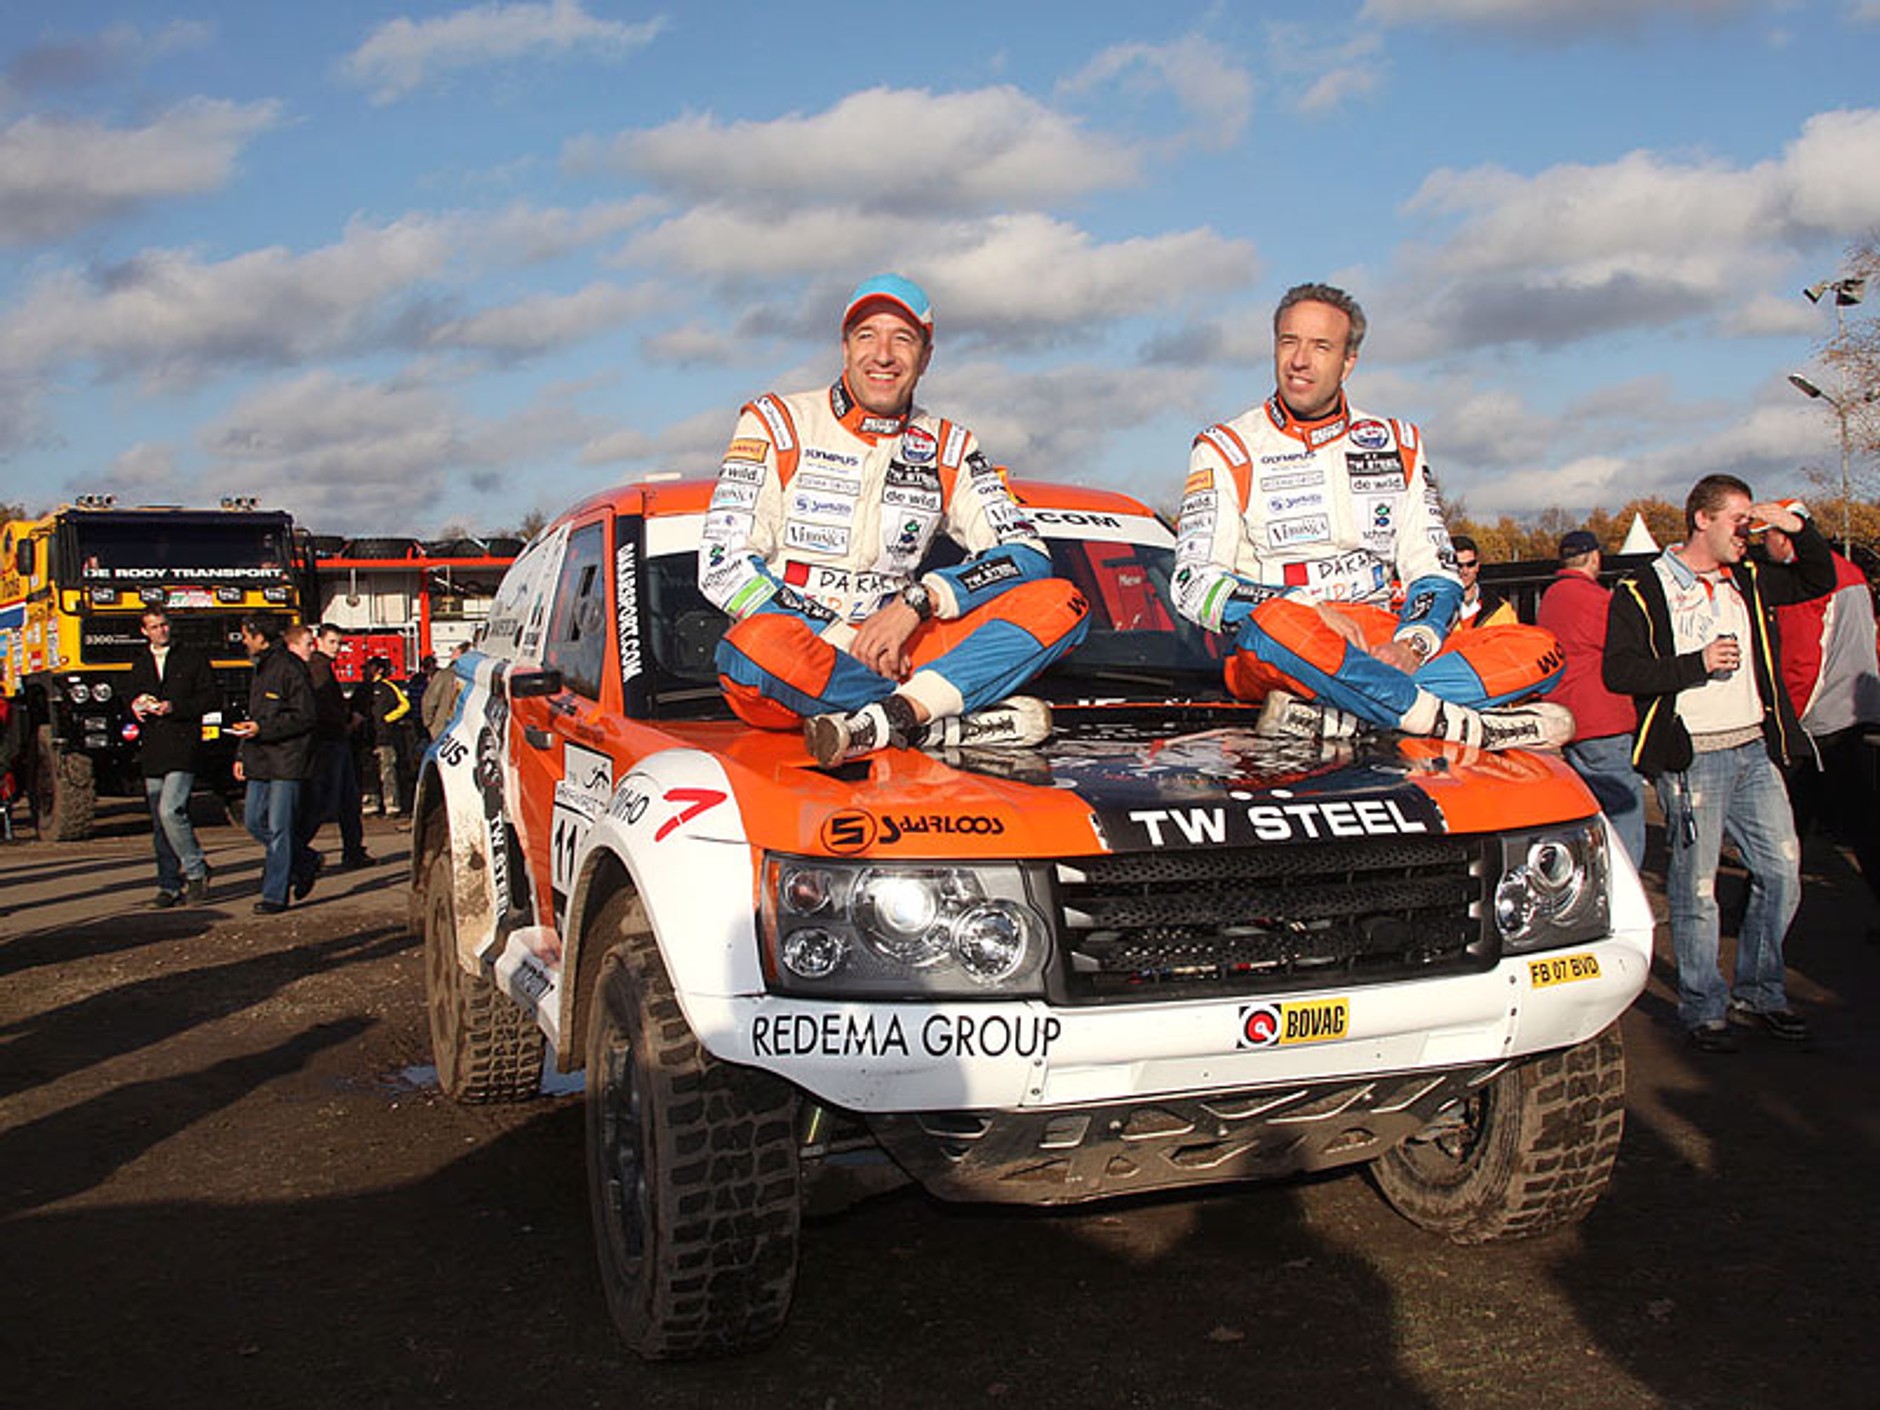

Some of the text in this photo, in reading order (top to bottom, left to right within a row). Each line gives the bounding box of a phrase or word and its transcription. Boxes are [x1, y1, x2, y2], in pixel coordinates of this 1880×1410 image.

[886, 489, 905, 501] de
[171, 568, 283, 578] TRANSPORT
[1130, 800, 1428, 847] TW STEEL
[1531, 961, 1550, 984] FB
[1553, 960, 1567, 980] 07
[752, 1014, 1062, 1057] REDEMA GROUP
[1285, 1006, 1345, 1038] BOVAG
